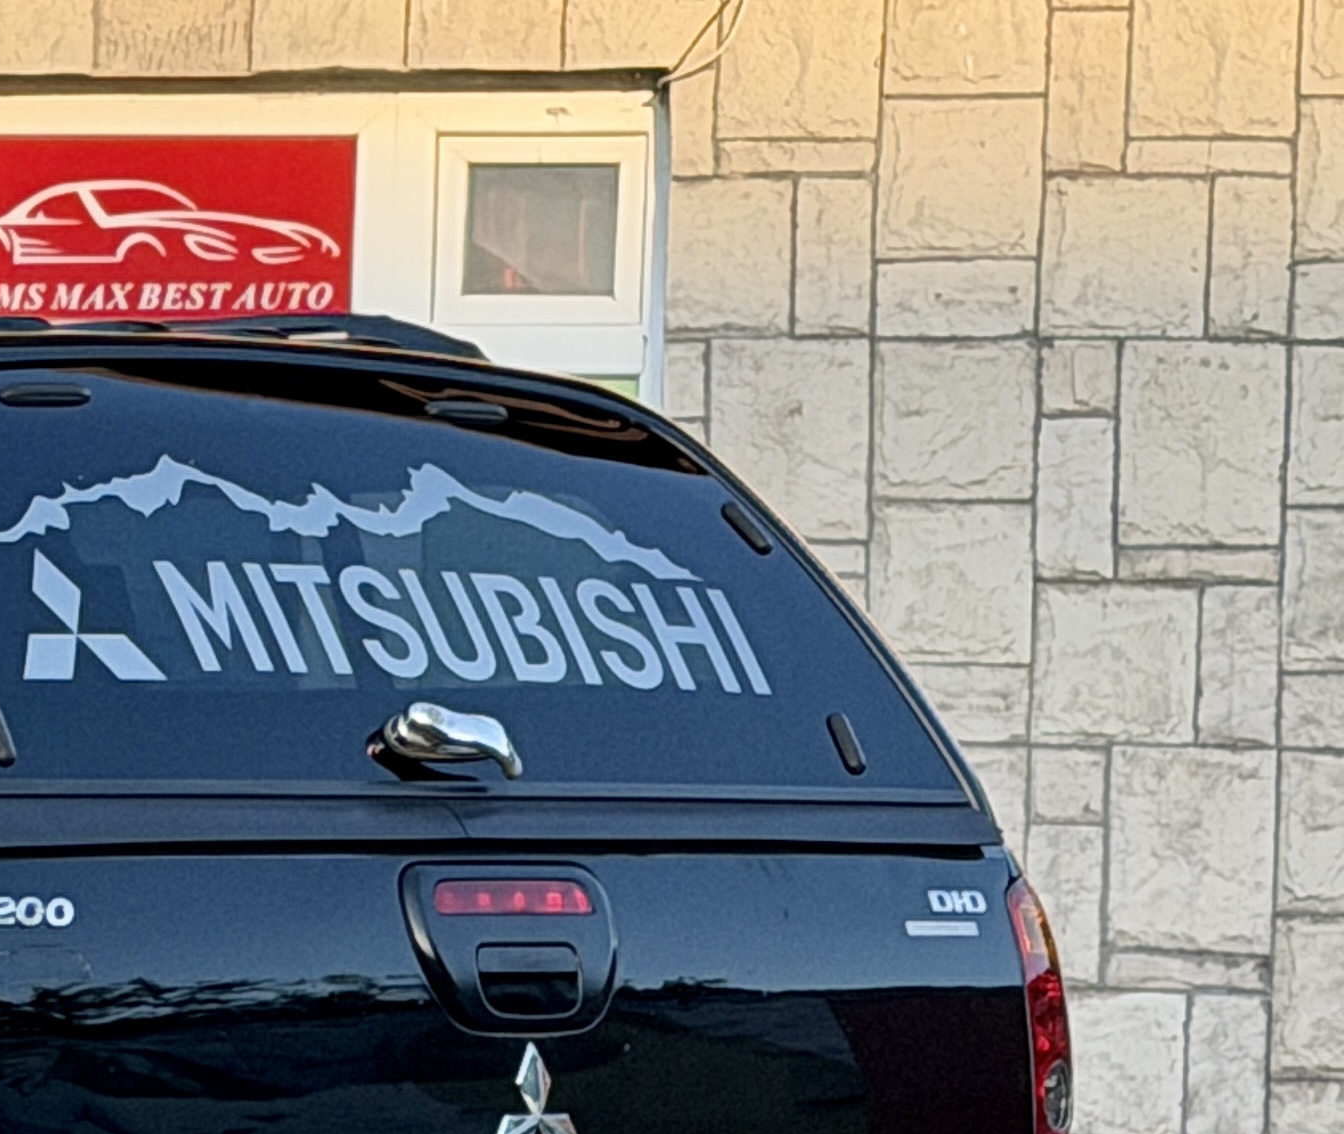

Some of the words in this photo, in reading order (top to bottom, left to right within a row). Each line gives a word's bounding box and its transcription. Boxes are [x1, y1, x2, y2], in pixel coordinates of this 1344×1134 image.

[49, 283, 134, 312] MAX
[137, 283, 232, 312] BEST
[231, 282, 334, 312] AUTO
[153, 559, 772, 695] MITSUBISHI
